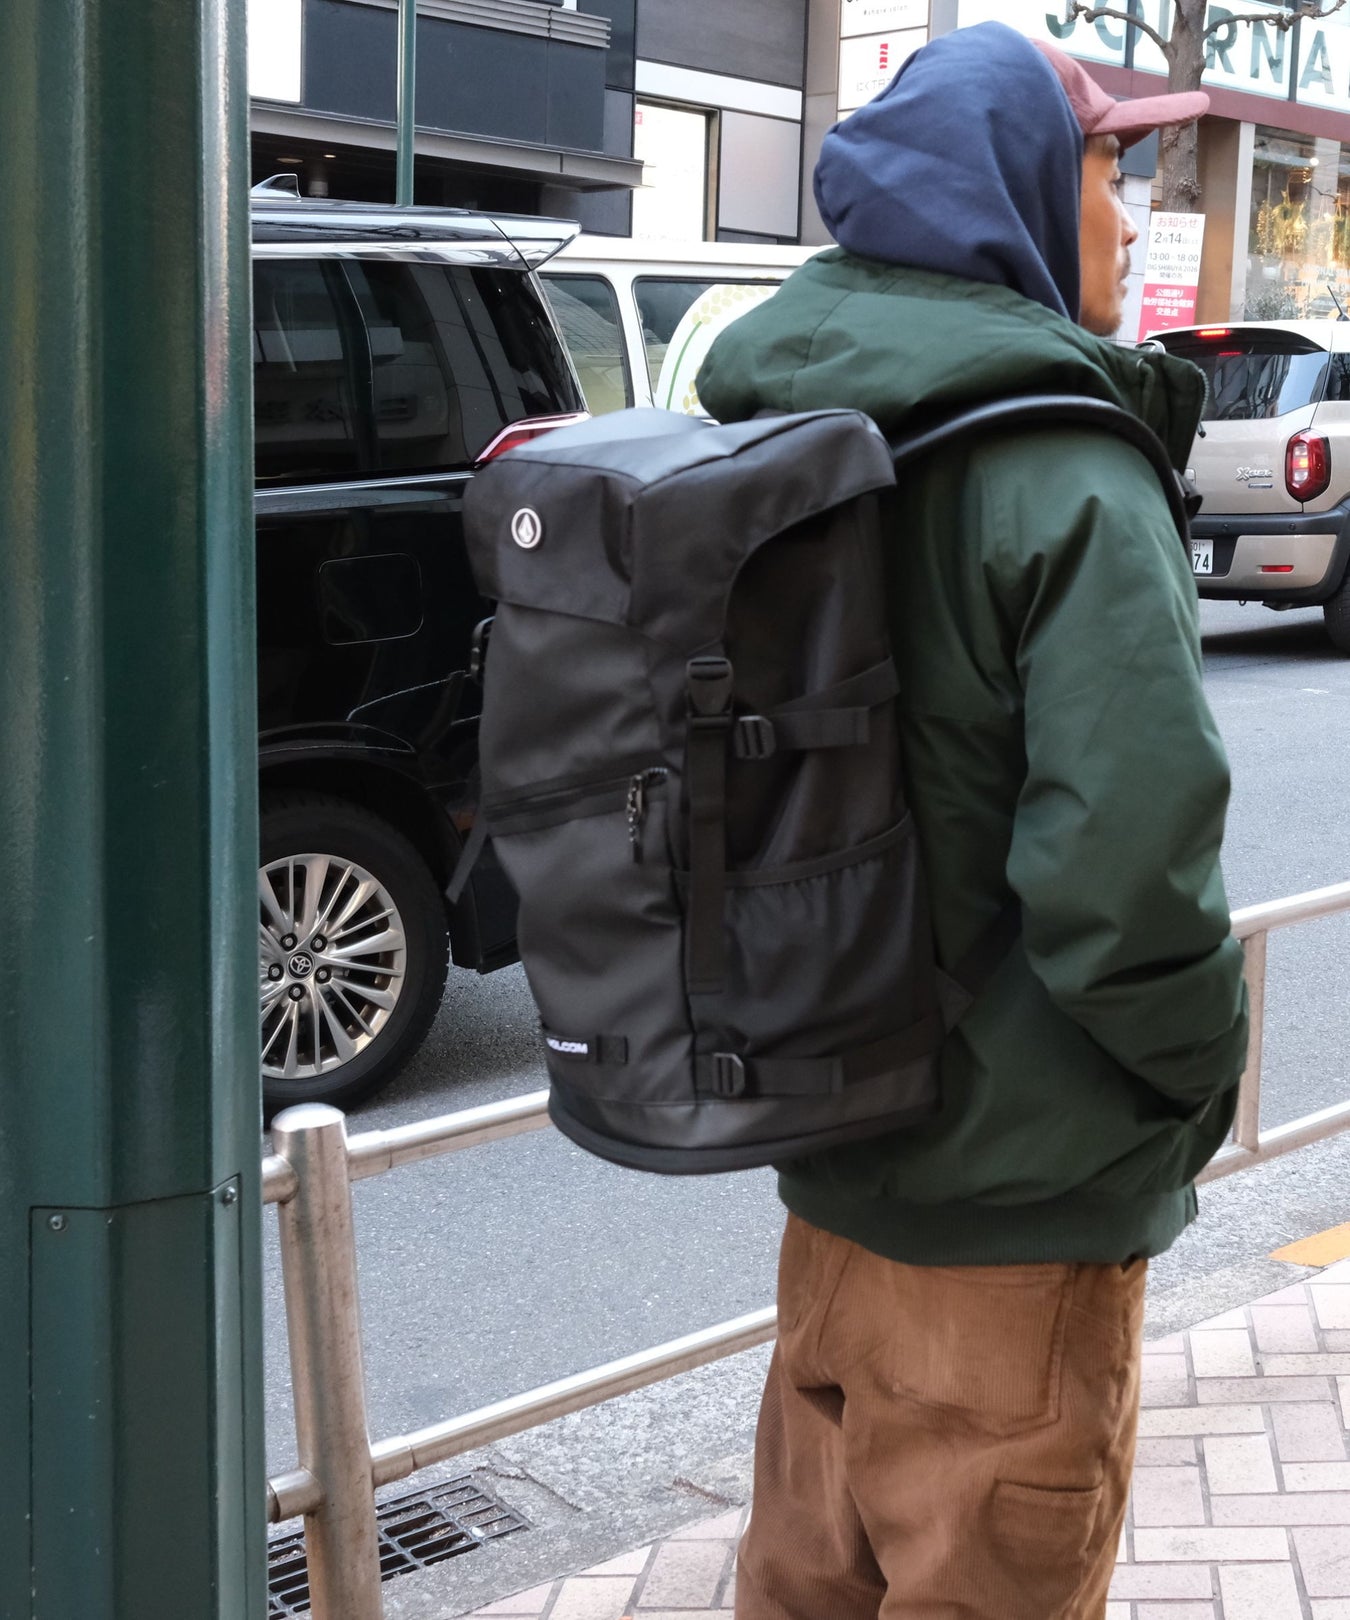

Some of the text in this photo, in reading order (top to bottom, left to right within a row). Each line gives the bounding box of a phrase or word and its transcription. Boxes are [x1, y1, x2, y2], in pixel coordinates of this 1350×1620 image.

[1157, 217, 1198, 229] お知らせ
[1194, 553, 1209, 571] 74
